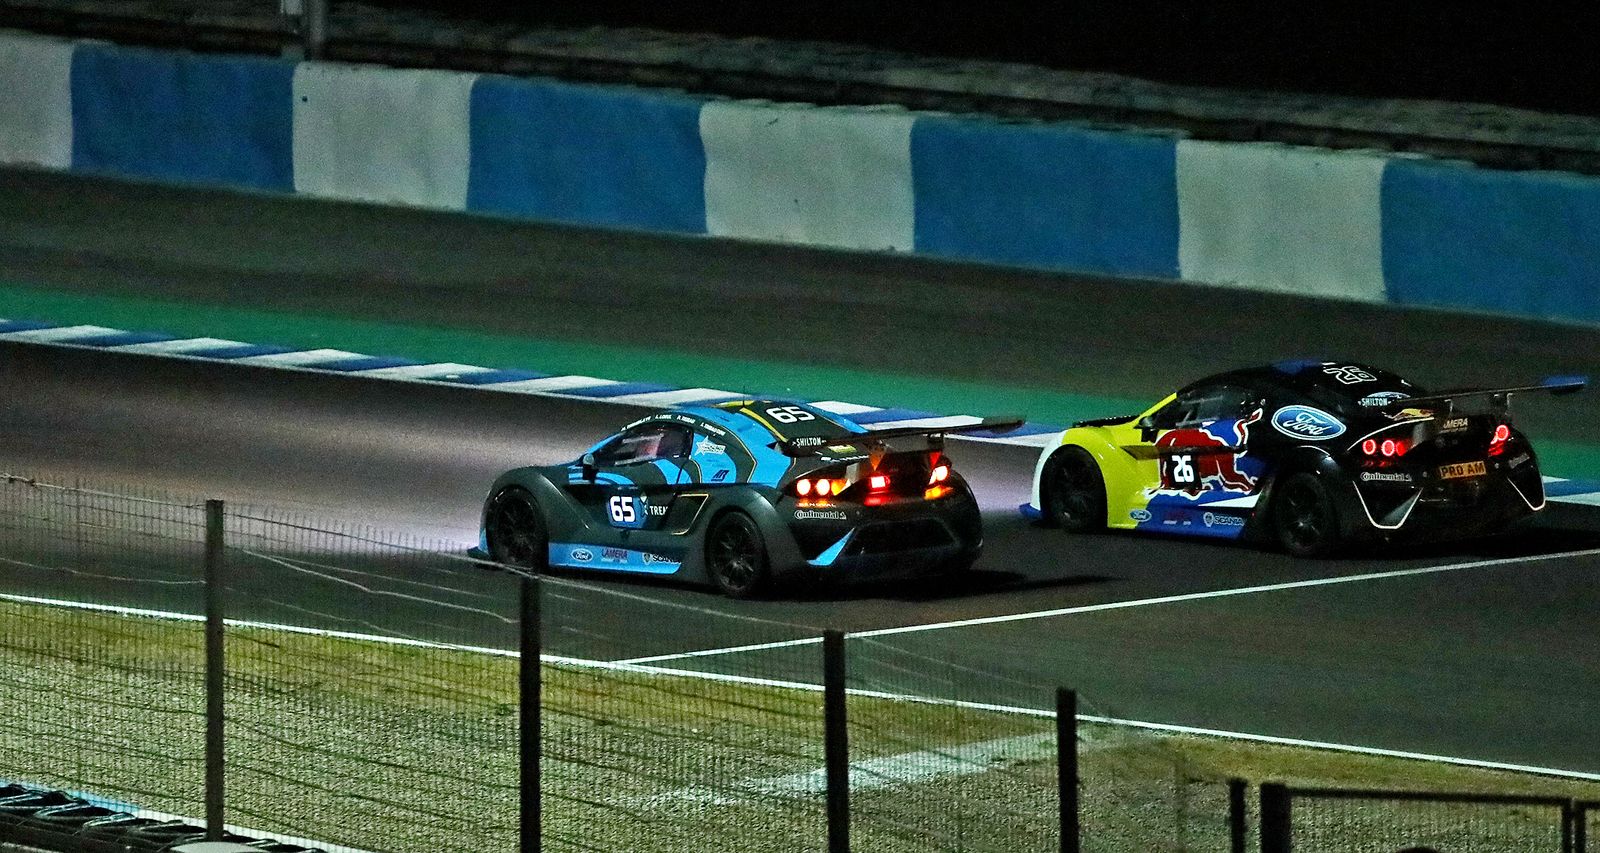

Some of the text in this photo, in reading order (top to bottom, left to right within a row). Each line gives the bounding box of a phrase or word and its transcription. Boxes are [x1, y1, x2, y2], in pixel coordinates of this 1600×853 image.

[1361, 398, 1388, 407] SHILTON
[766, 406, 815, 423] 65
[1283, 412, 1333, 435] Ford
[796, 437, 822, 448] SHILTON
[1171, 455, 1194, 482] 26
[1360, 471, 1405, 481] Continental
[1441, 462, 1485, 477] PRO AM
[609, 496, 636, 522] 65
[794, 510, 839, 519] Continental
